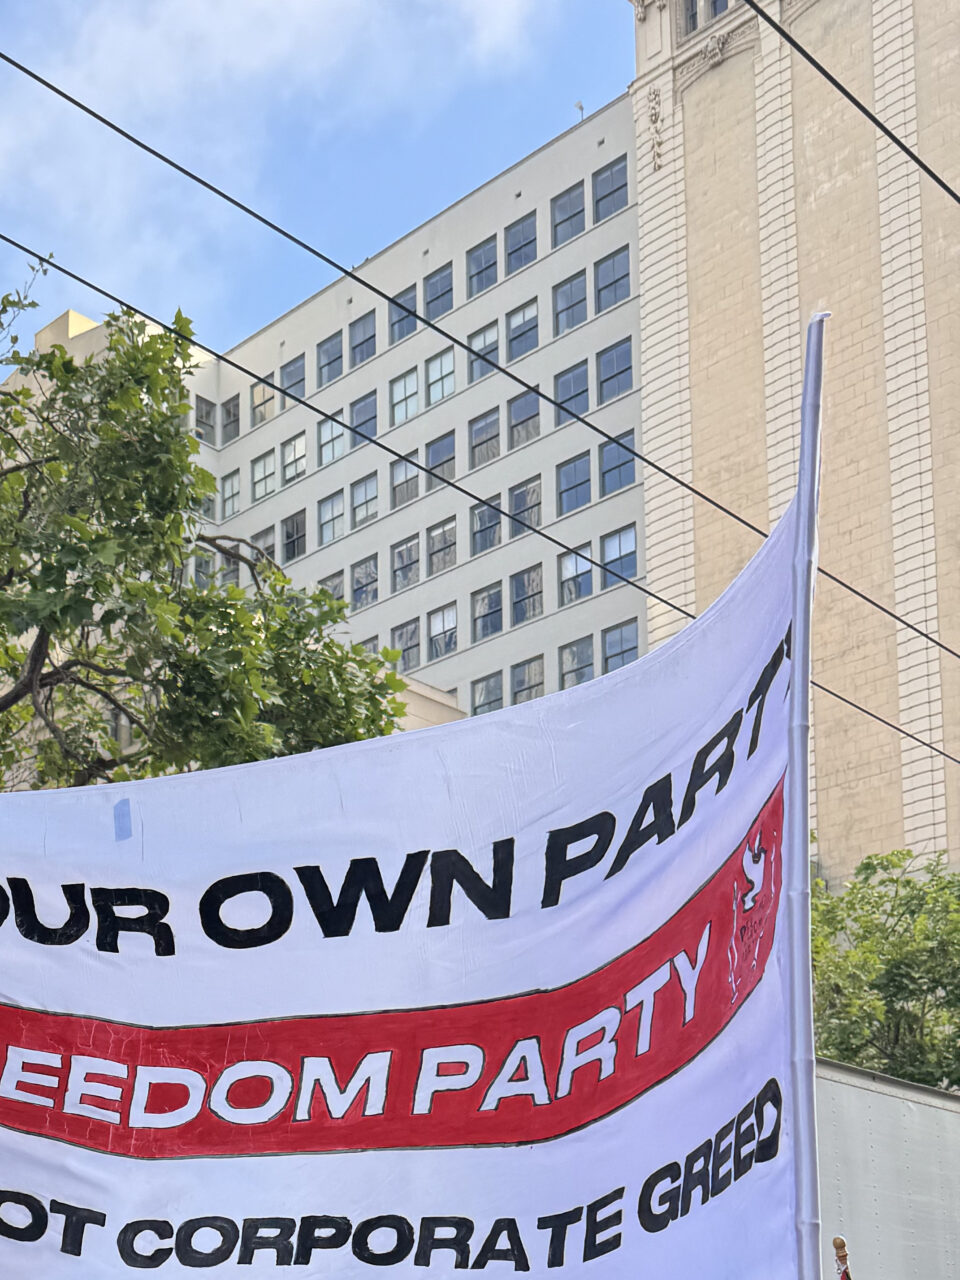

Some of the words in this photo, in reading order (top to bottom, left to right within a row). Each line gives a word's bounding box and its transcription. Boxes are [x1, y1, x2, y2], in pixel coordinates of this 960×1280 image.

[199, 837, 514, 949] OWN
[541, 619, 792, 909] PART
[412, 920, 713, 1115] PARTY
[116, 1186, 625, 1272] CORPORATE
[637, 1077, 783, 1232] GREED
